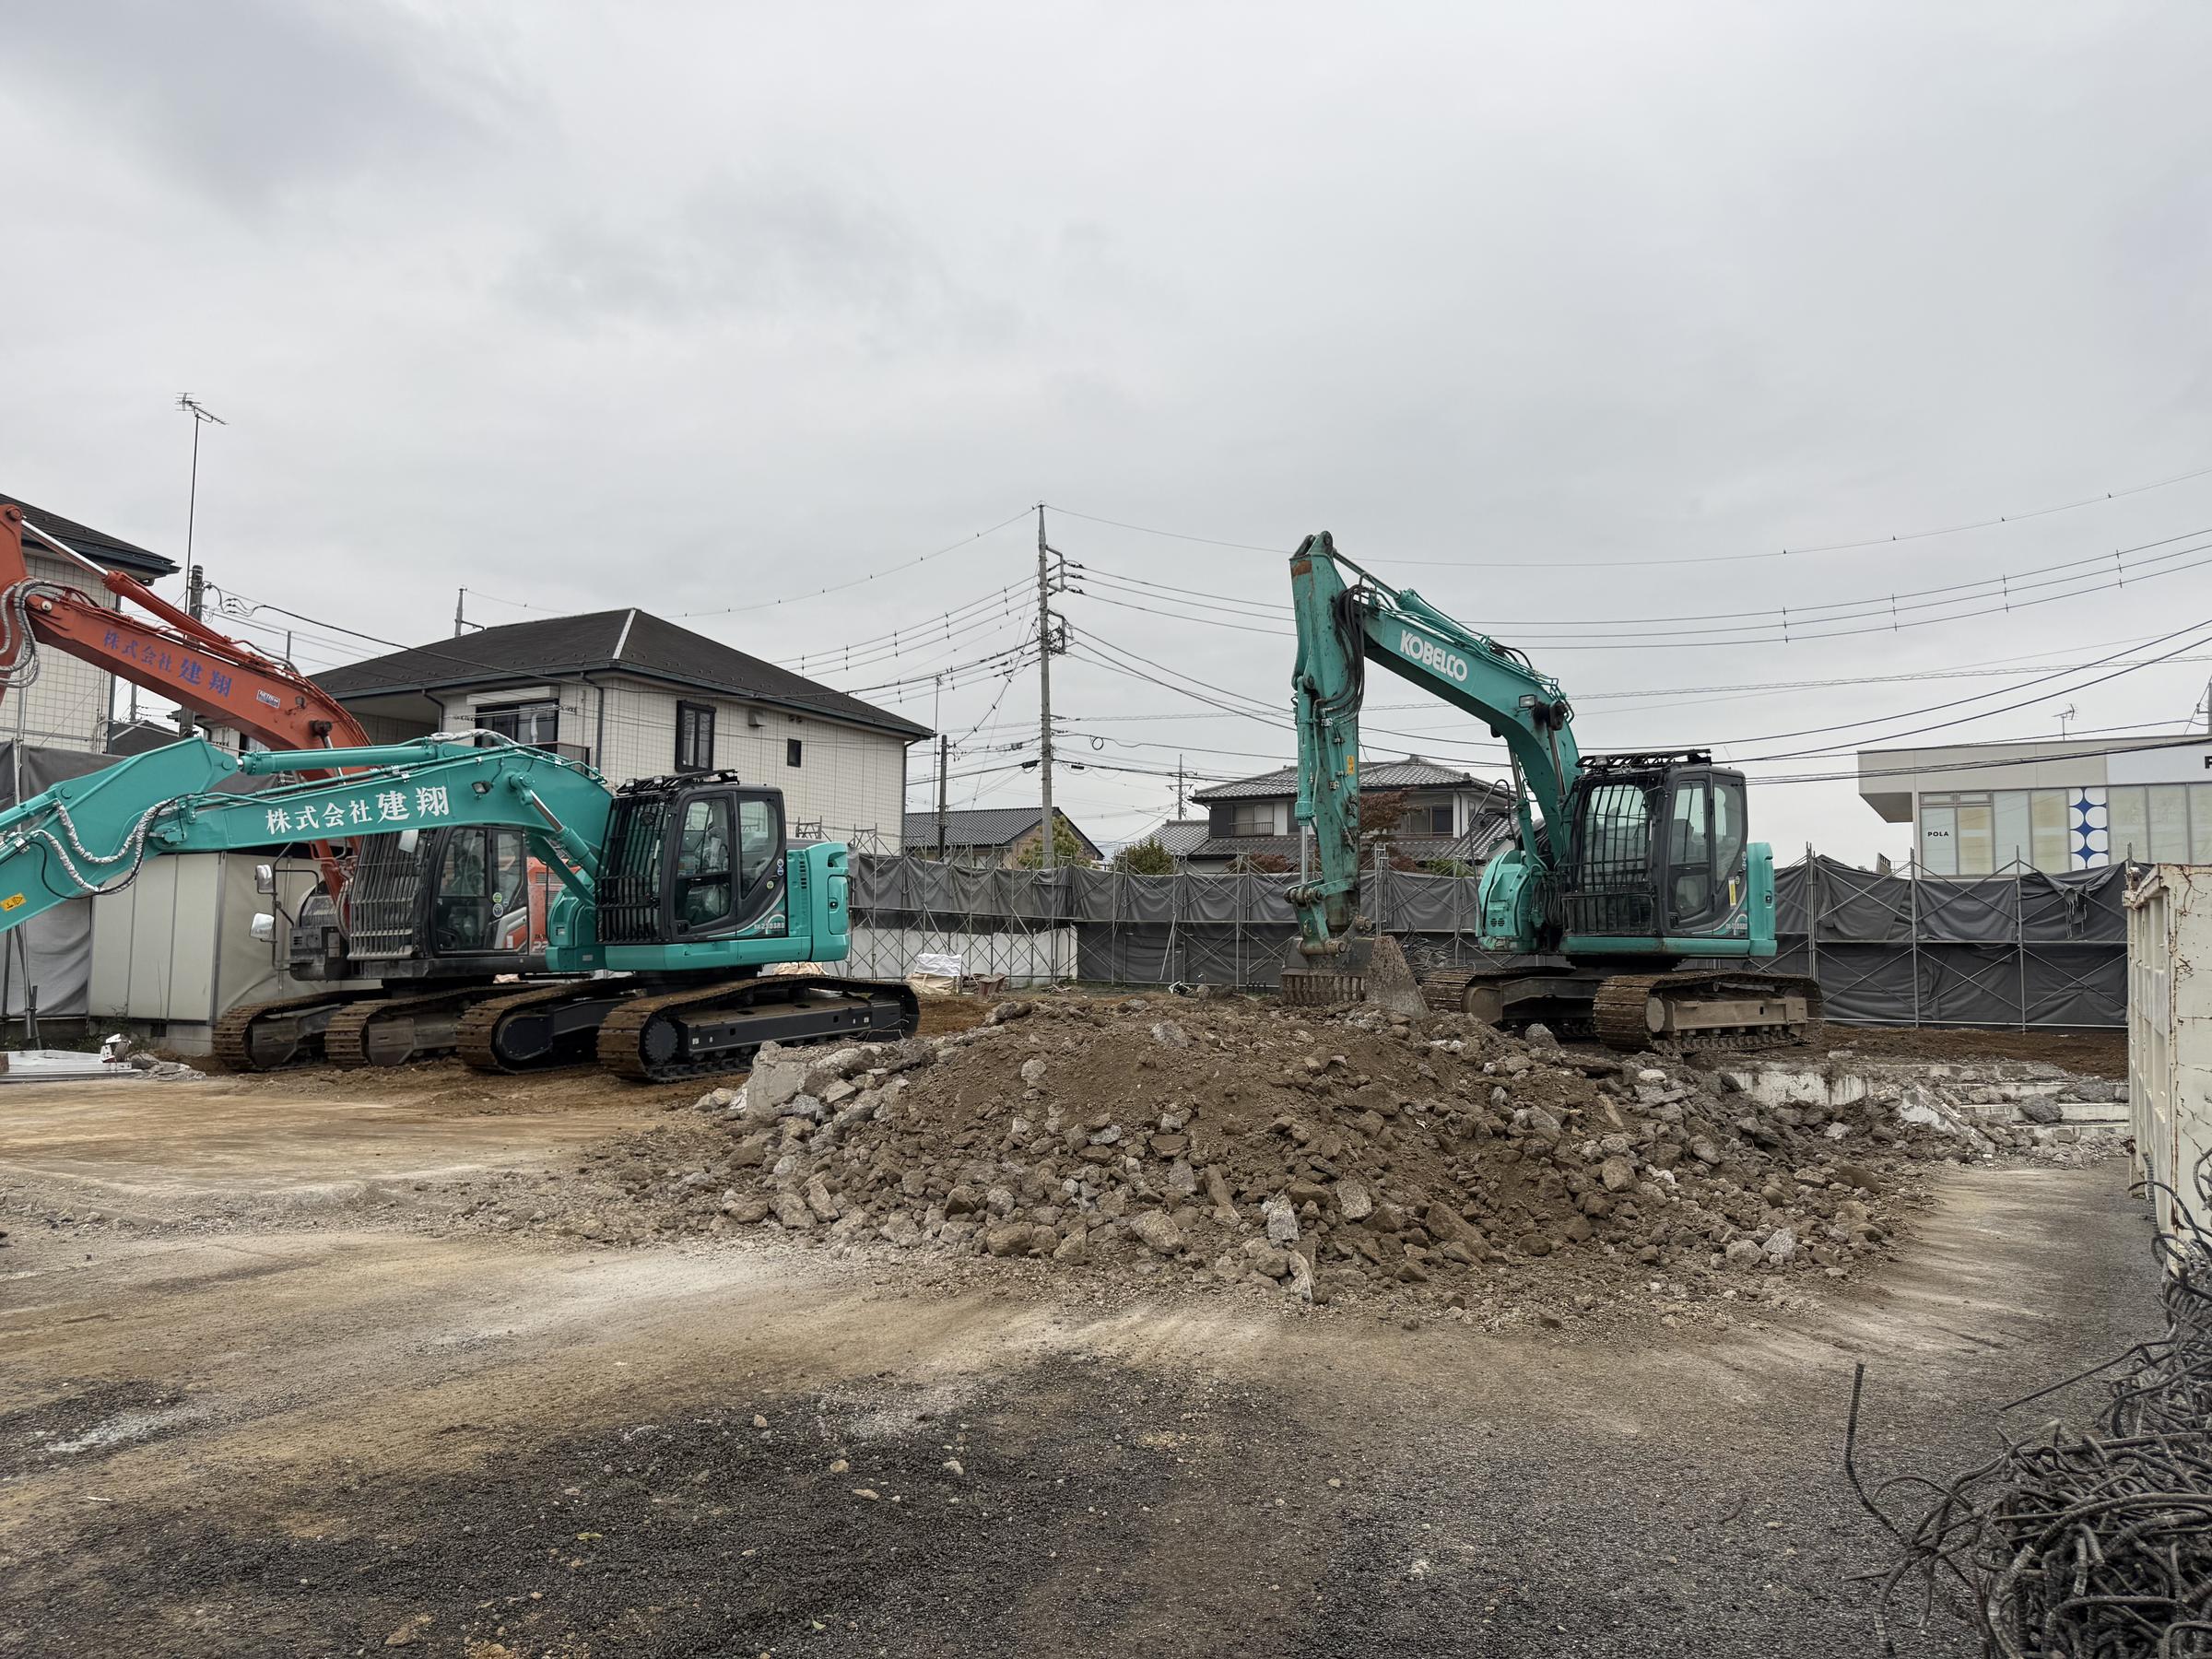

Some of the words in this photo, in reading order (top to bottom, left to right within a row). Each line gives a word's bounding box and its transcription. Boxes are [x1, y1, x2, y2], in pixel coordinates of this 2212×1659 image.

[103, 629, 233, 698] 株式会社建翔
[1400, 629, 1468, 682] KOBELCO
[265, 784, 450, 835] 株式会社建翔
